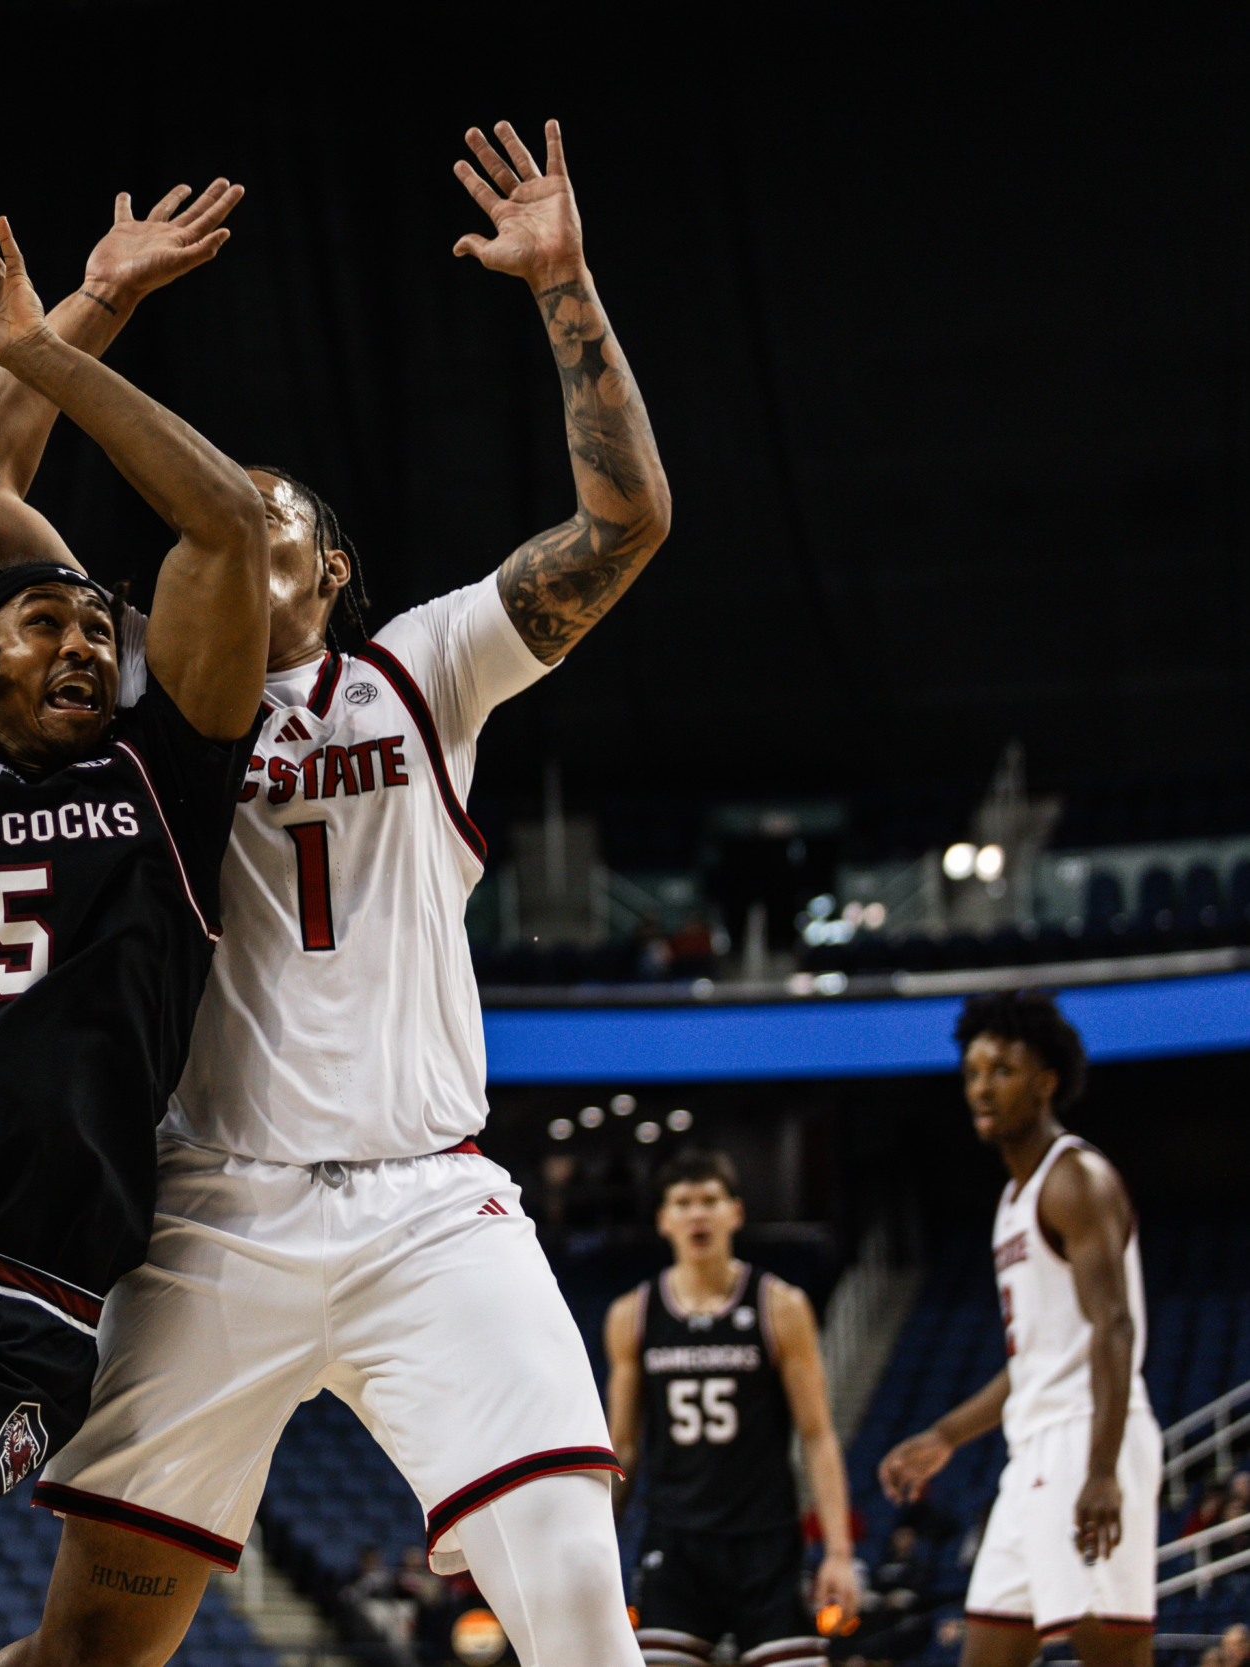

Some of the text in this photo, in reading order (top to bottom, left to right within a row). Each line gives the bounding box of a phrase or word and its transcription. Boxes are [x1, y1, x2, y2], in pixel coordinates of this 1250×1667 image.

[283, 820, 336, 952] 1
[667, 1378, 738, 1446] 55
[90, 1564, 178, 1596] HUMBLE
